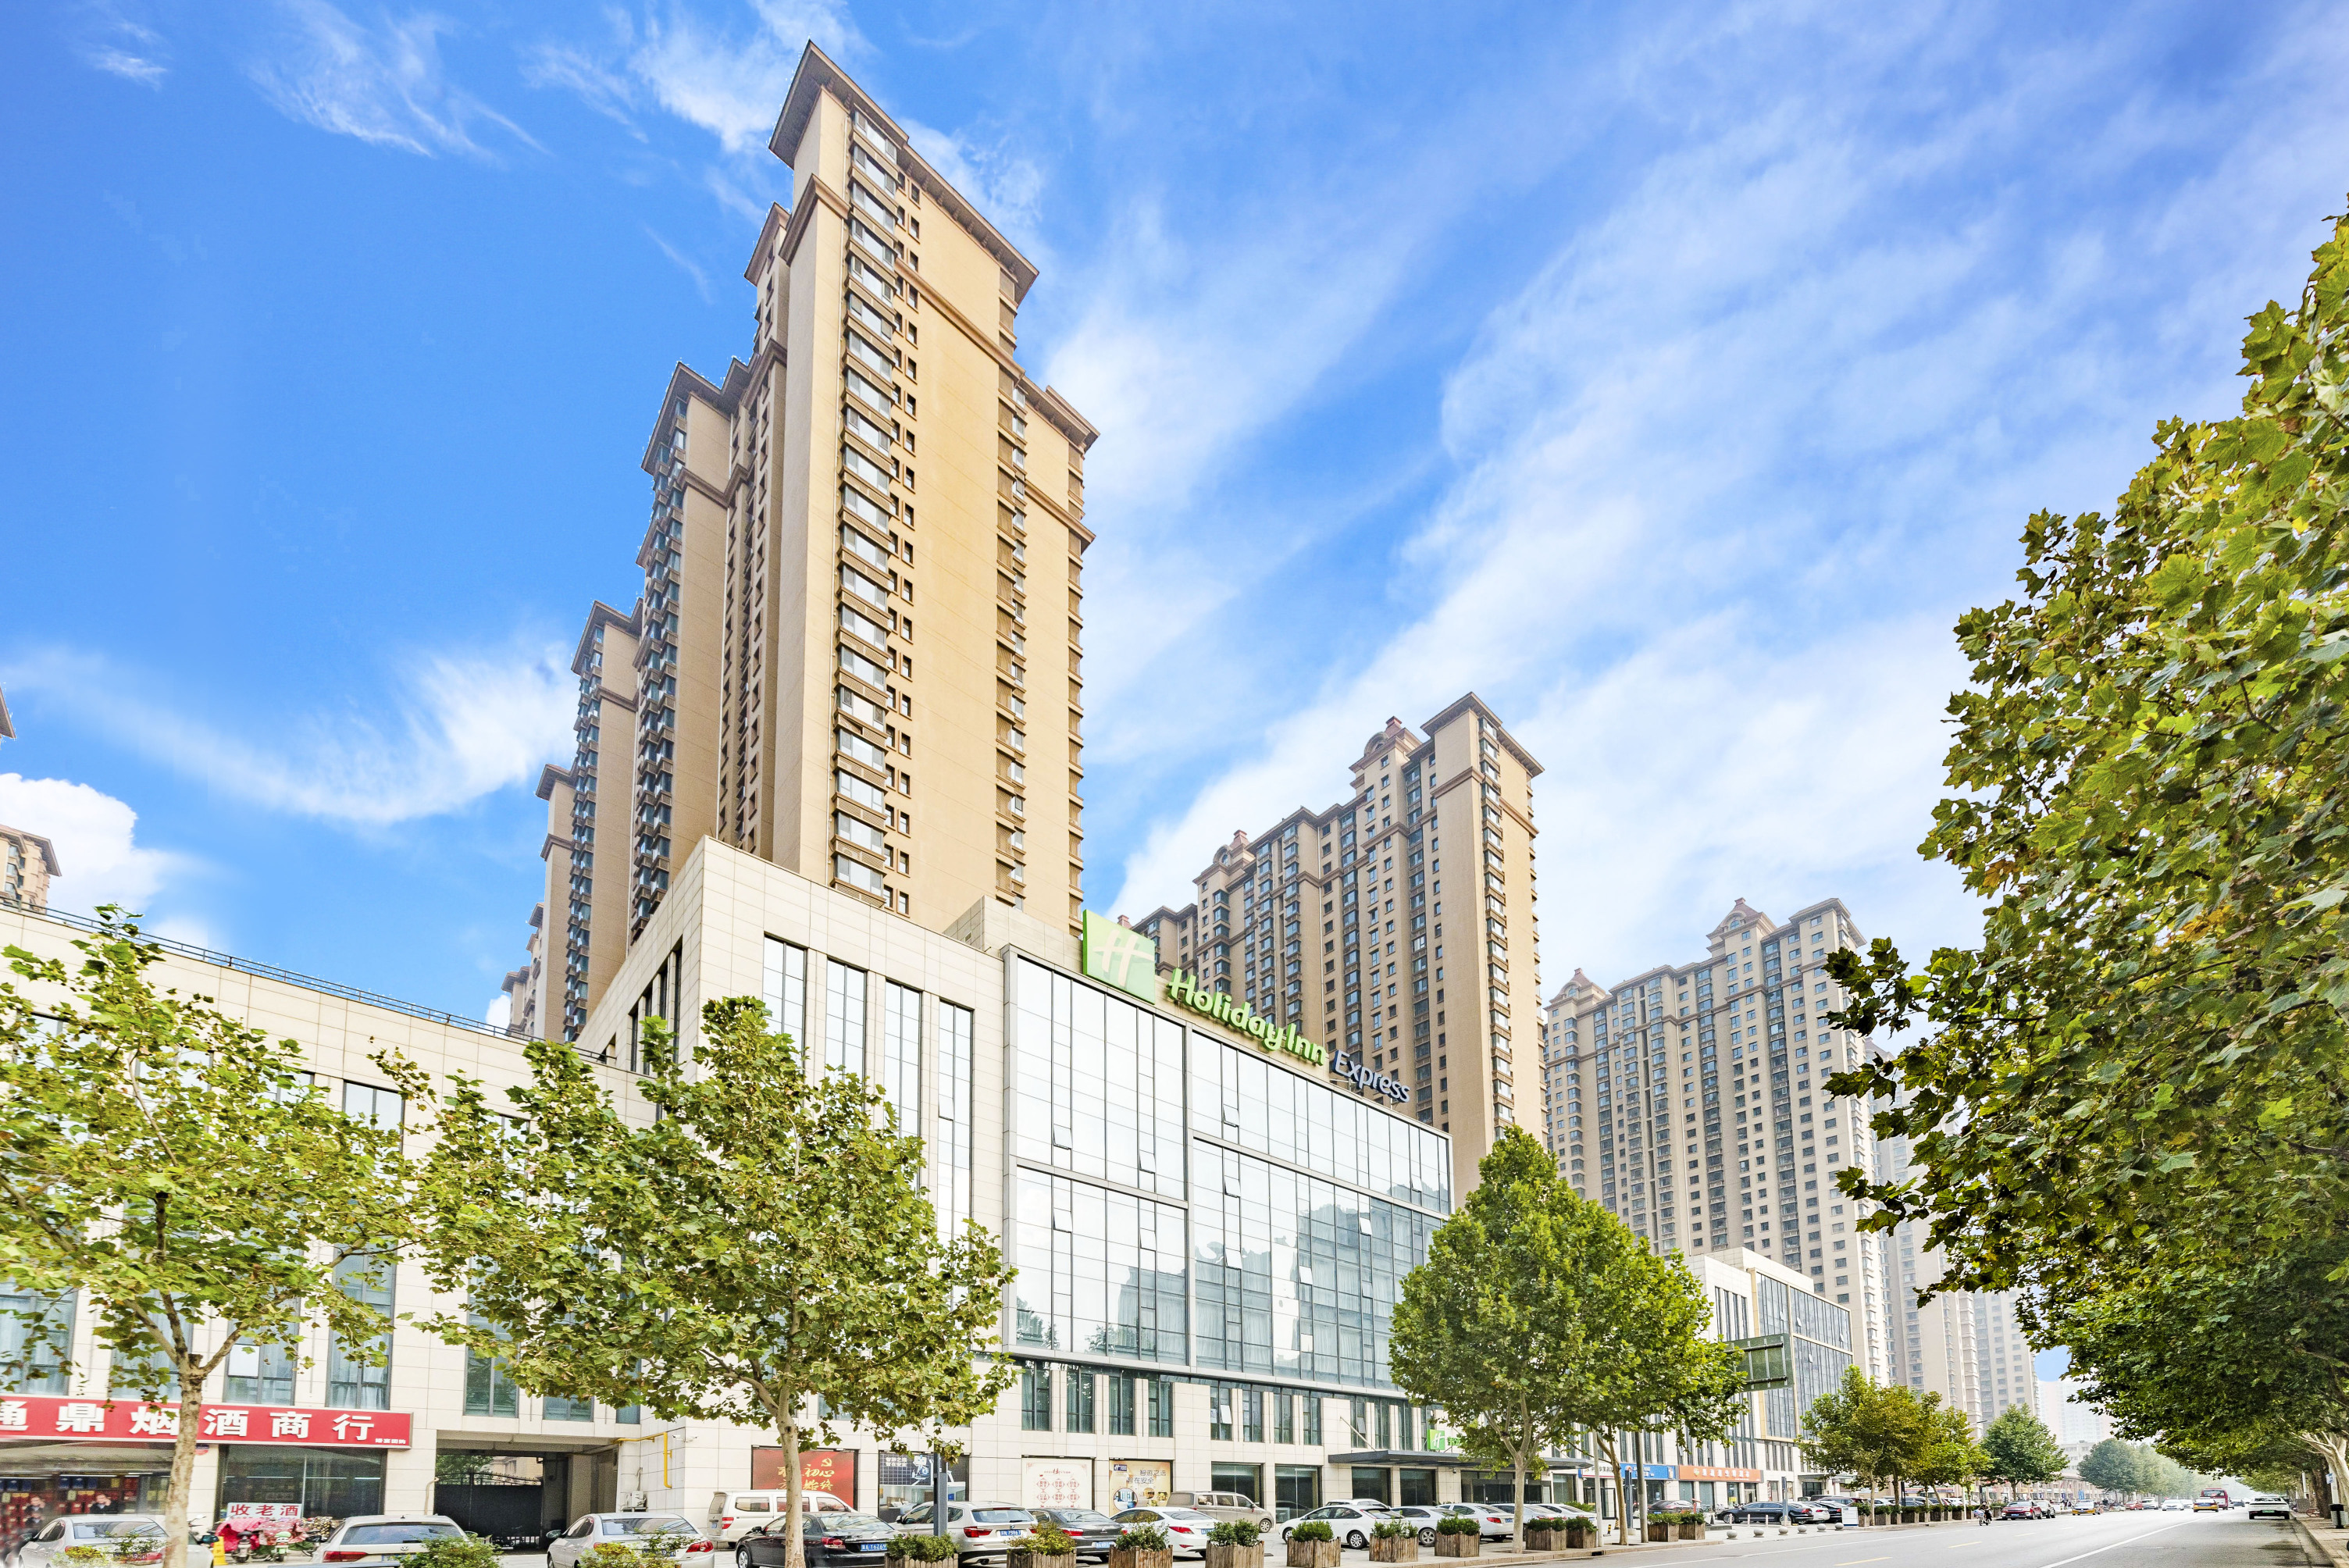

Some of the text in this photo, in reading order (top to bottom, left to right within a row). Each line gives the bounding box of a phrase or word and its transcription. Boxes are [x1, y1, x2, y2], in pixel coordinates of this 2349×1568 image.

[1167, 968, 1327, 1066] Holiday Inn
[1332, 1049, 1410, 1103] Express
[230, 1504, 299, 1516] 收老酒
